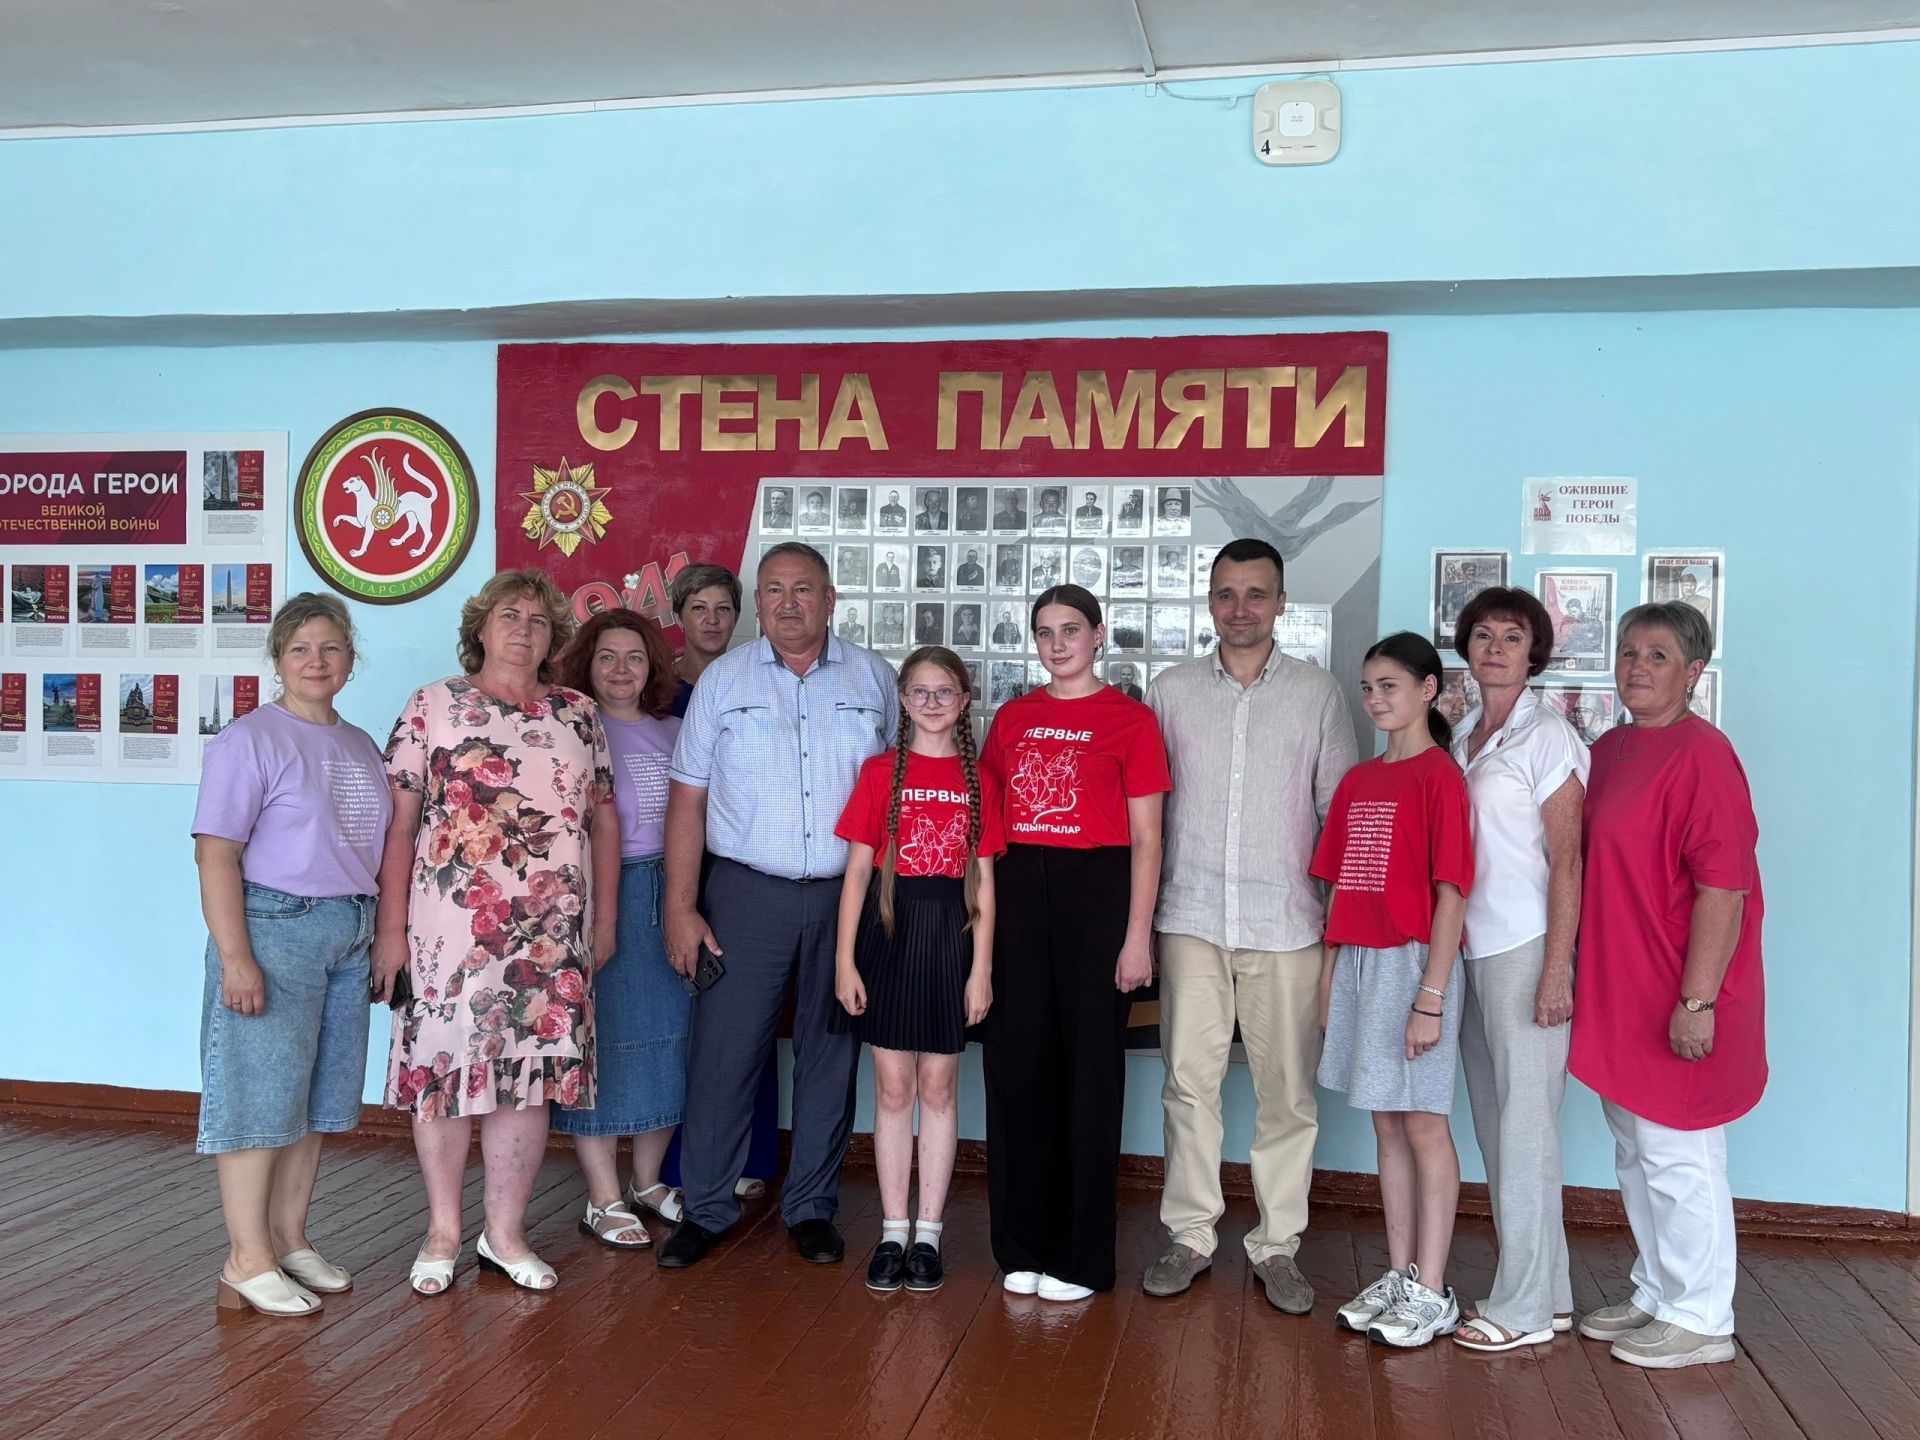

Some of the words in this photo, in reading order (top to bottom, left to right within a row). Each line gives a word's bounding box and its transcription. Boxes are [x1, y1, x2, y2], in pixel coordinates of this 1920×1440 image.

[1260, 139, 1271, 155] 4
[575, 372, 890, 452] СТЕНА
[936, 365, 1368, 450] ПАМЯТИ
[0, 472, 85, 499] ОРОДА
[93, 472, 179, 495] ГЕРОИ
[1558, 485, 1629, 495] ОЖИВШИЕ
[41, 502, 106, 517] ВЕЛИКОЙ
[1572, 499, 1614, 509] ГЕРОИ
[0, 516, 106, 531] ТЕЧЕСТВЕННОЙ
[110, 516, 160, 531] ВОЙНЫ
[1565, 513, 1620, 524] ПОБЕДЫ
[339, 572, 430, 595] ТАТАРСТАН
[1022, 727, 1093, 742] ПЕРВЫЕ
[1012, 822, 1081, 834] ЛДЫНГЫЛАР
